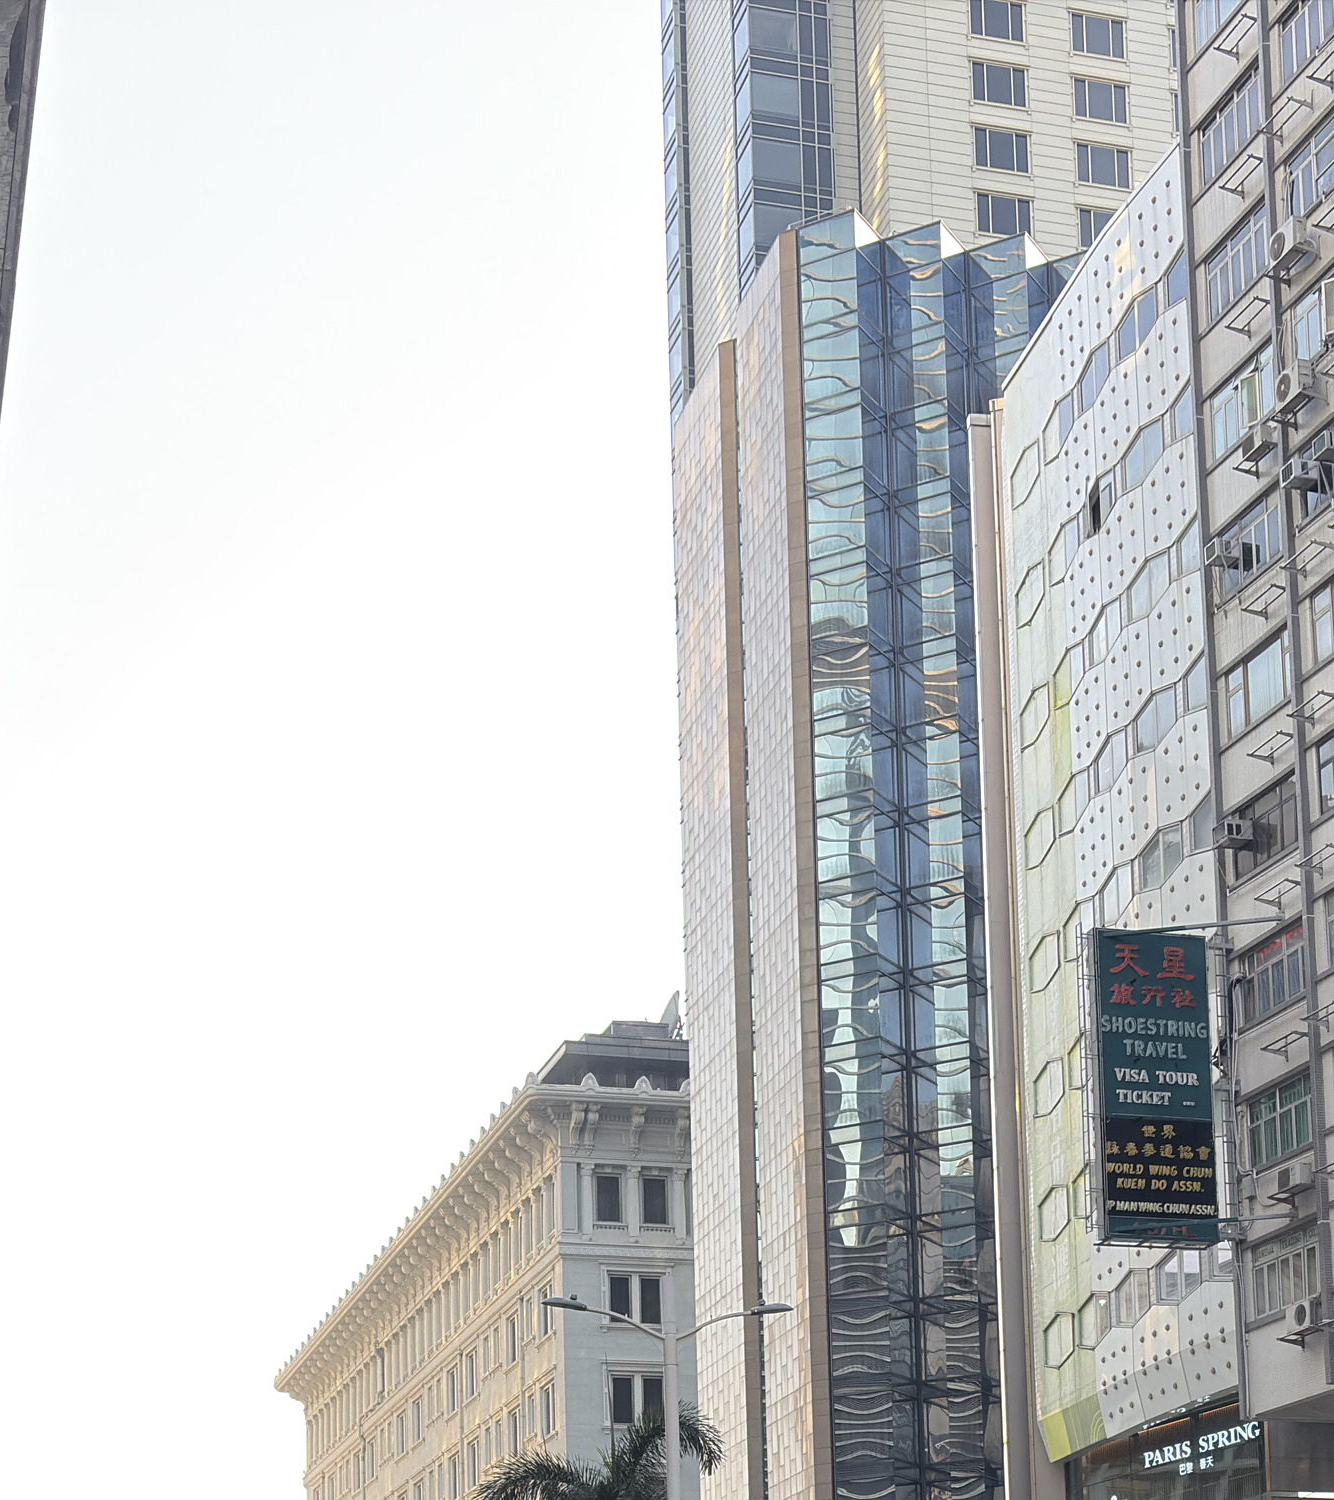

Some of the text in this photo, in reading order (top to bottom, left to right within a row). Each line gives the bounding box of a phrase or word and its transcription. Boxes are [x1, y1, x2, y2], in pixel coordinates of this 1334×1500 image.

[1109, 944, 1195, 981] 天星
[1110, 983, 1197, 1008] 旅行社
[1101, 1014, 1207, 1039] SHOESTRING
[1123, 1039, 1187, 1060] TRAVEL
[1114, 1067, 1199, 1086] VISA TOUR
[1116, 1089, 1171, 1105] TICKET
[1141, 1124, 1176, 1139] 世界
[1106, 1162, 1213, 1178] WORLD WING CHUN
[1116, 1177, 1205, 1192] KUEN DO ASSN.
[1116, 1200, 1137, 1211] MAN
[1138, 1202, 1163, 1213] WING
[1163, 1202, 1188, 1214] CHUN
[1143, 1421, 1261, 1468] PARIS SPRING
[1178, 1455, 1214, 1476] 巴黎 春天
